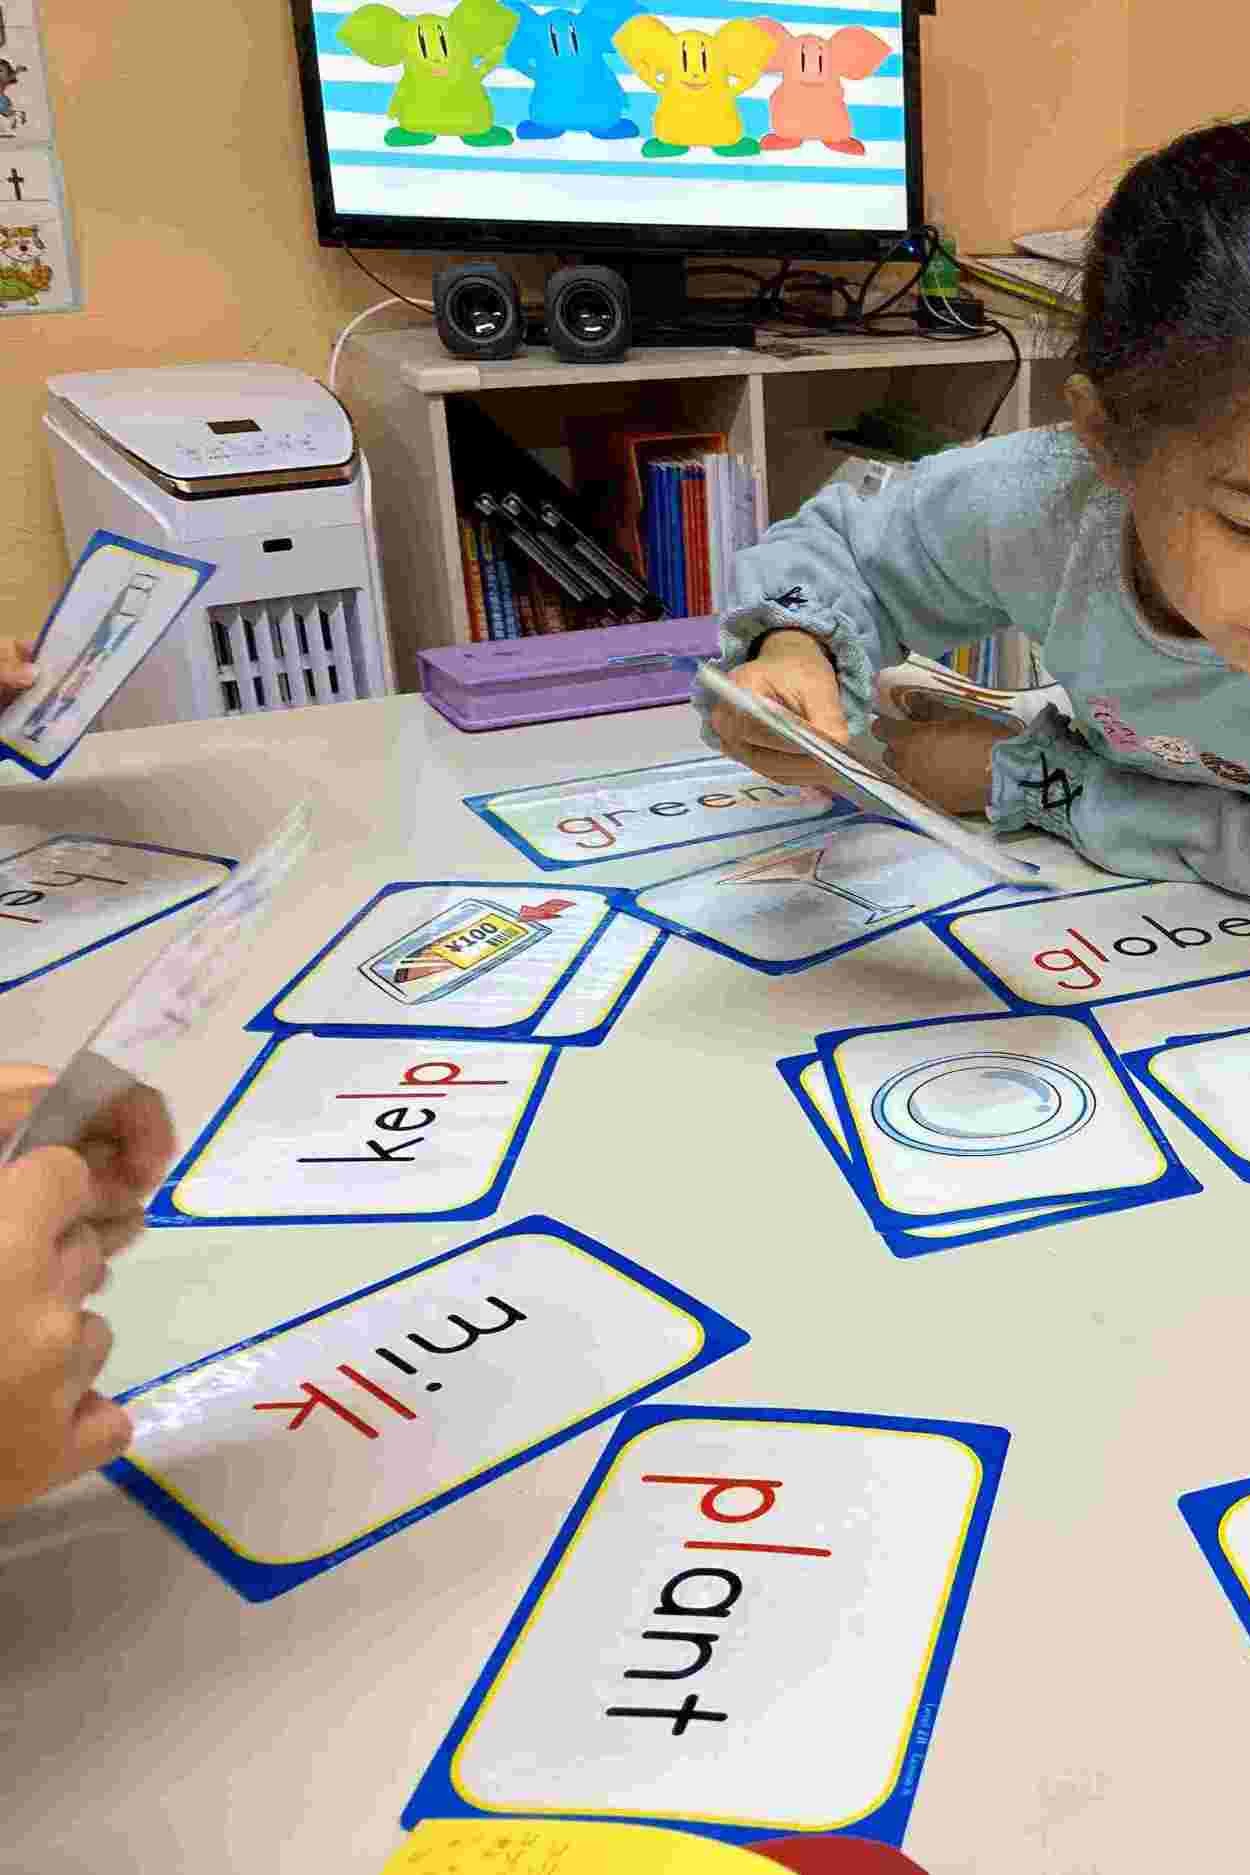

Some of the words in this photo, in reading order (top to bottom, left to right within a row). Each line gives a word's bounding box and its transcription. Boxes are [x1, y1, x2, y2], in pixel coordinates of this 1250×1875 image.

[557, 783, 785, 849] green
[295, 1061, 511, 1165] kelp
[251, 1295, 528, 1441] milk
[604, 1472, 834, 1738] plant
